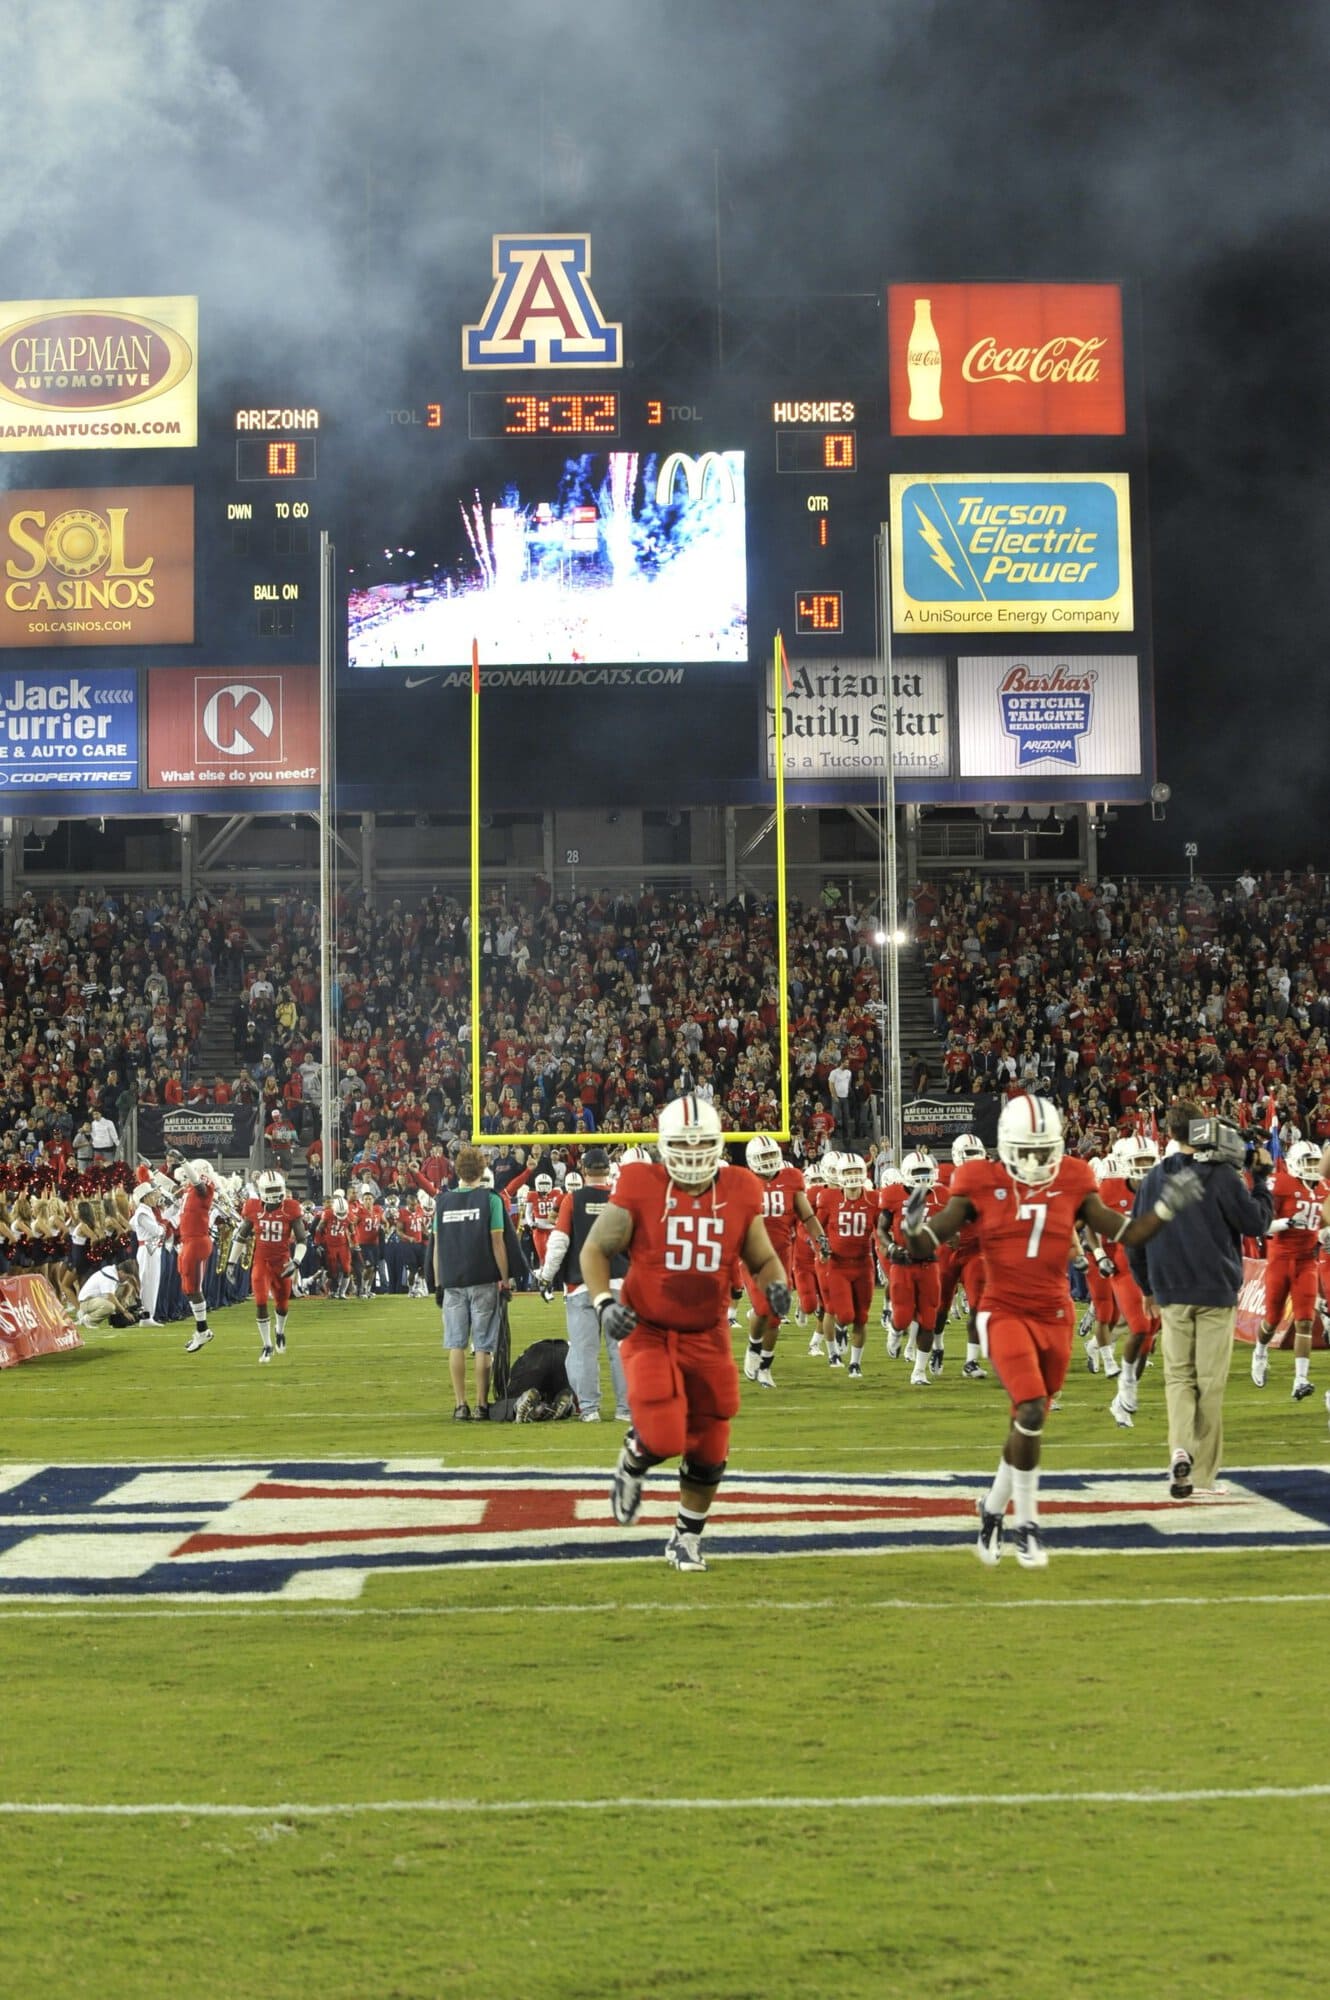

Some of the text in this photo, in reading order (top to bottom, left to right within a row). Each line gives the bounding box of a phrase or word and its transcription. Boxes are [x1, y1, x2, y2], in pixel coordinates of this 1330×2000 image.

[11, 335, 152, 373] CHAPMAN
[962, 337, 1107, 383] Coca-Cola
[15, 373, 150, 389] AUTOMOTIVE
[236, 409, 319, 430] ARIZONA
[386, 409, 421, 424] TOL
[427, 404, 441, 427] 3
[505, 395, 615, 432] 3:32
[647, 401, 661, 424] 3
[667, 406, 702, 422] TOL
[774, 401, 855, 423] HUSKIES
[268, 443, 296, 475] 0
[825, 435, 853, 467] 0
[228, 504, 252, 519] DWN
[276, 503, 308, 518] TO GO
[807, 496, 829, 511] QTR
[957, 496, 1068, 526] Tucson
[6, 508, 154, 579] SOL
[968, 527, 1098, 554] Electric
[983, 555, 1098, 584] Power
[5, 579, 154, 611] CASINOS
[254, 585, 298, 600] BALL ON
[800, 597, 839, 627] 40
[904, 608, 1120, 625] A UniSource Energy Company
[28, 620, 132, 633] SOLCASINOS.COM
[442, 668, 684, 687] ARZONAWILDCATS.COM
[5, 679, 91, 711] Jack
[1008, 697, 1085, 709] OFFICIAL
[208, 686, 272, 754] K
[1008, 710, 1085, 723] TAILGATE
[1009, 722, 1085, 732] HEADQUARTERS
[14, 746, 25, 758] &
[31, 745, 78, 757] AUTO
[82, 744, 127, 757] CARE
[1022, 740, 1073, 750] ARIZONA
[802, 756, 812, 768] a
[820, 752, 884, 768] Tucson
[161, 768, 316, 782] What else do you need?
[567, 850, 579, 863] 28
[1185, 842, 1198, 856] 29
[903, 1107, 944, 1115] AMERICAN
[164, 1117, 233, 1125] AMERICAN FAMILY
[442, 1208, 480, 1223] ESPN
[838, 1211, 867, 1237] 50
[259, 1220, 283, 1242] 39
[1018, 1203, 1048, 1258] 7
[665, 1216, 724, 1272] 55
